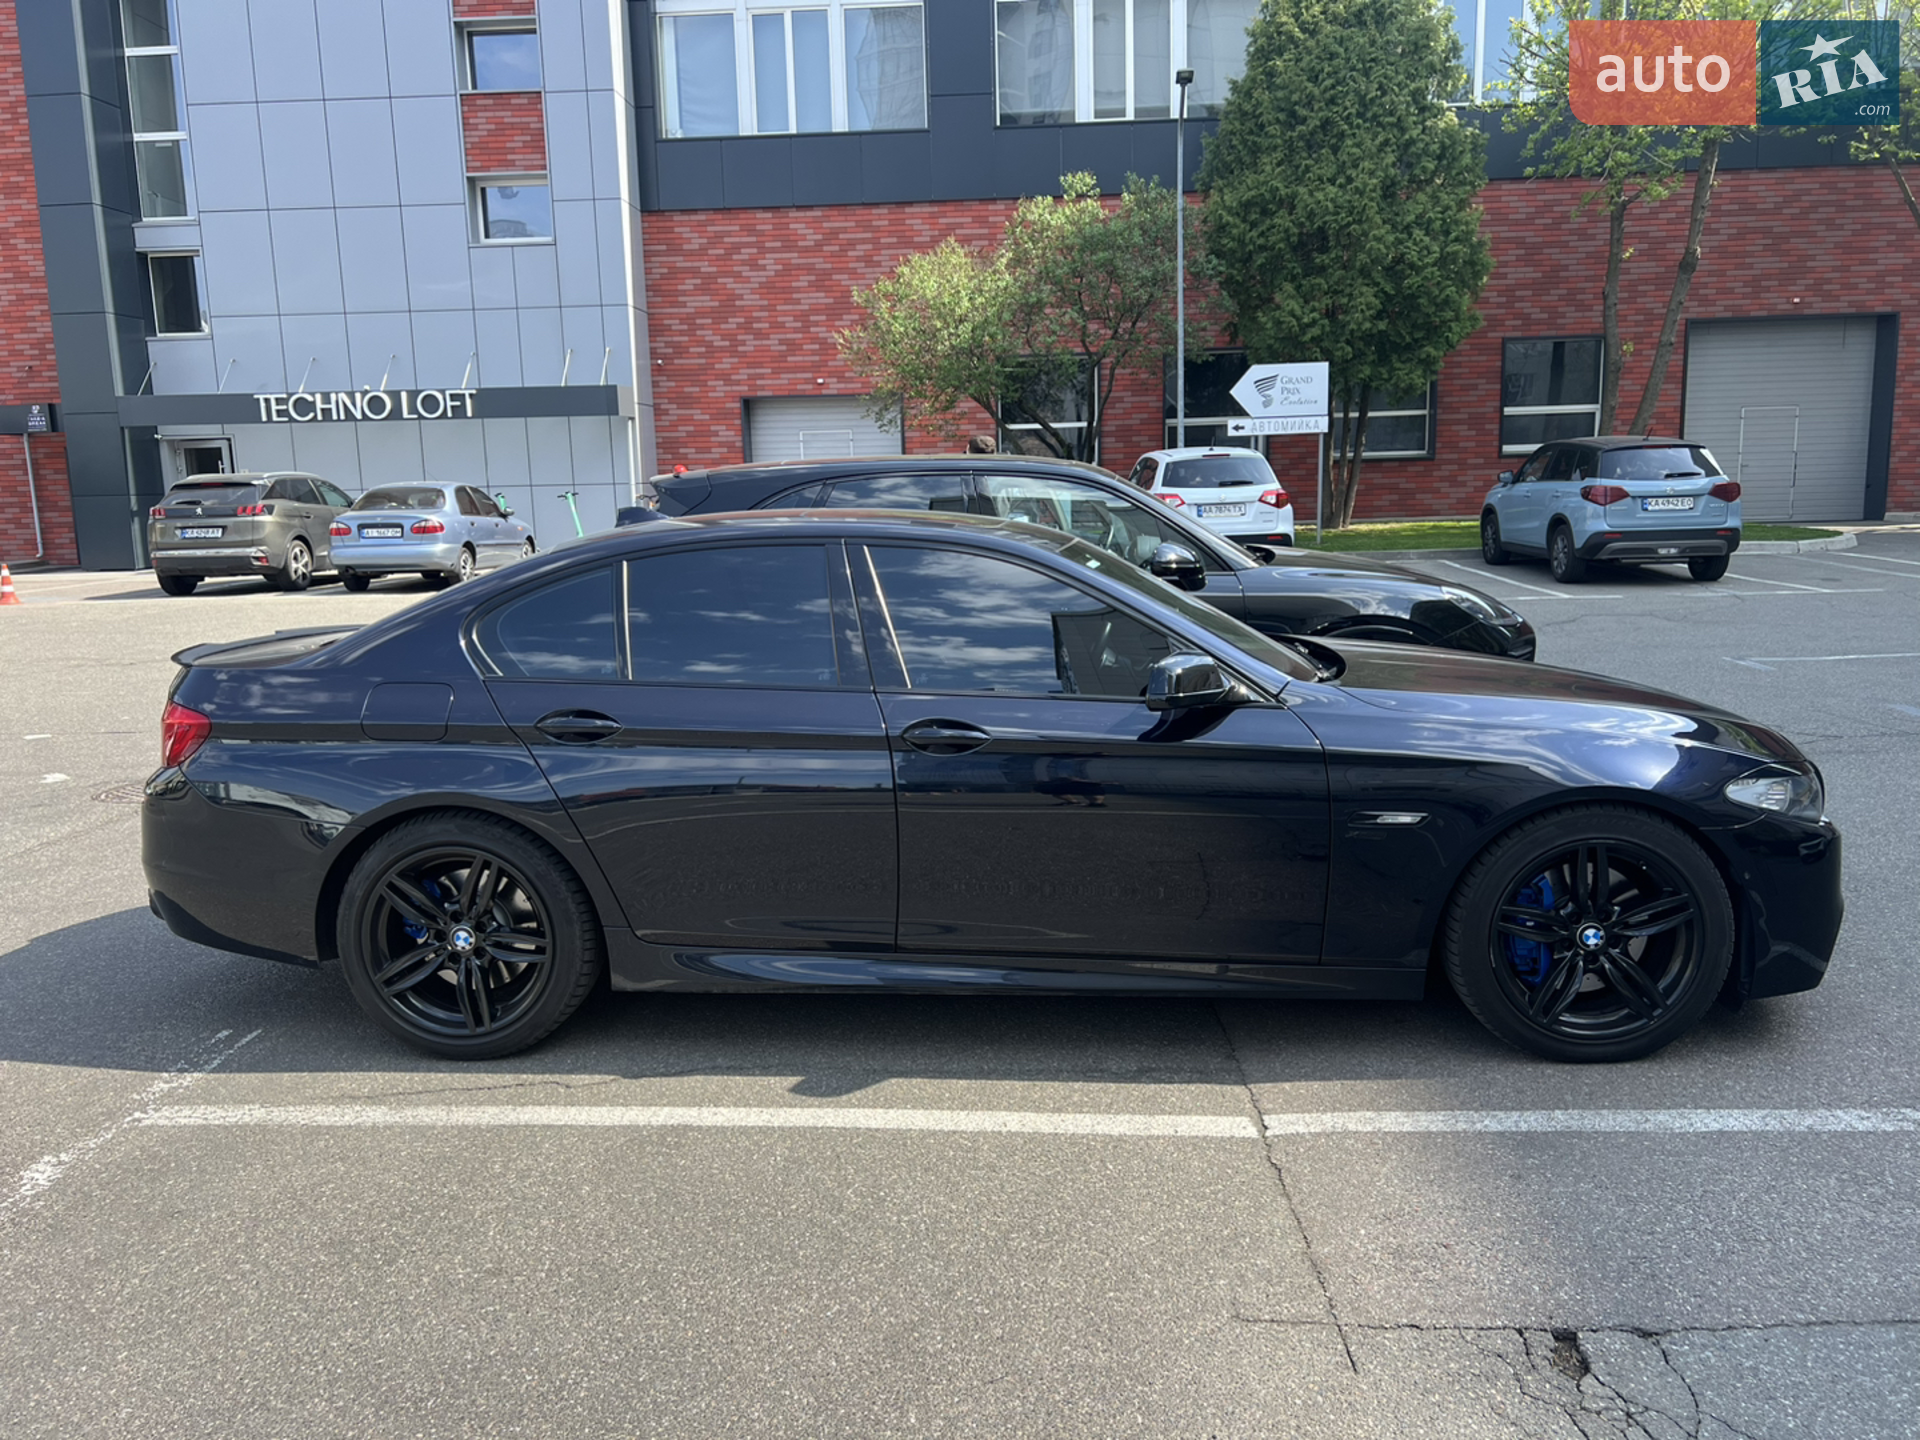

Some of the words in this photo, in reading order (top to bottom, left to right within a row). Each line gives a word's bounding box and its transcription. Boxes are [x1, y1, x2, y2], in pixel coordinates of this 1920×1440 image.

[1280, 375, 1313, 385] GRAND
[1280, 386, 1301, 396] PRIX
[253, 391, 392, 422] TECHNO
[400, 389, 477, 419] LOFT
[1280, 396, 1318, 406] Evolution
[1250, 419, 1320, 434] АВТОМИЙКА
